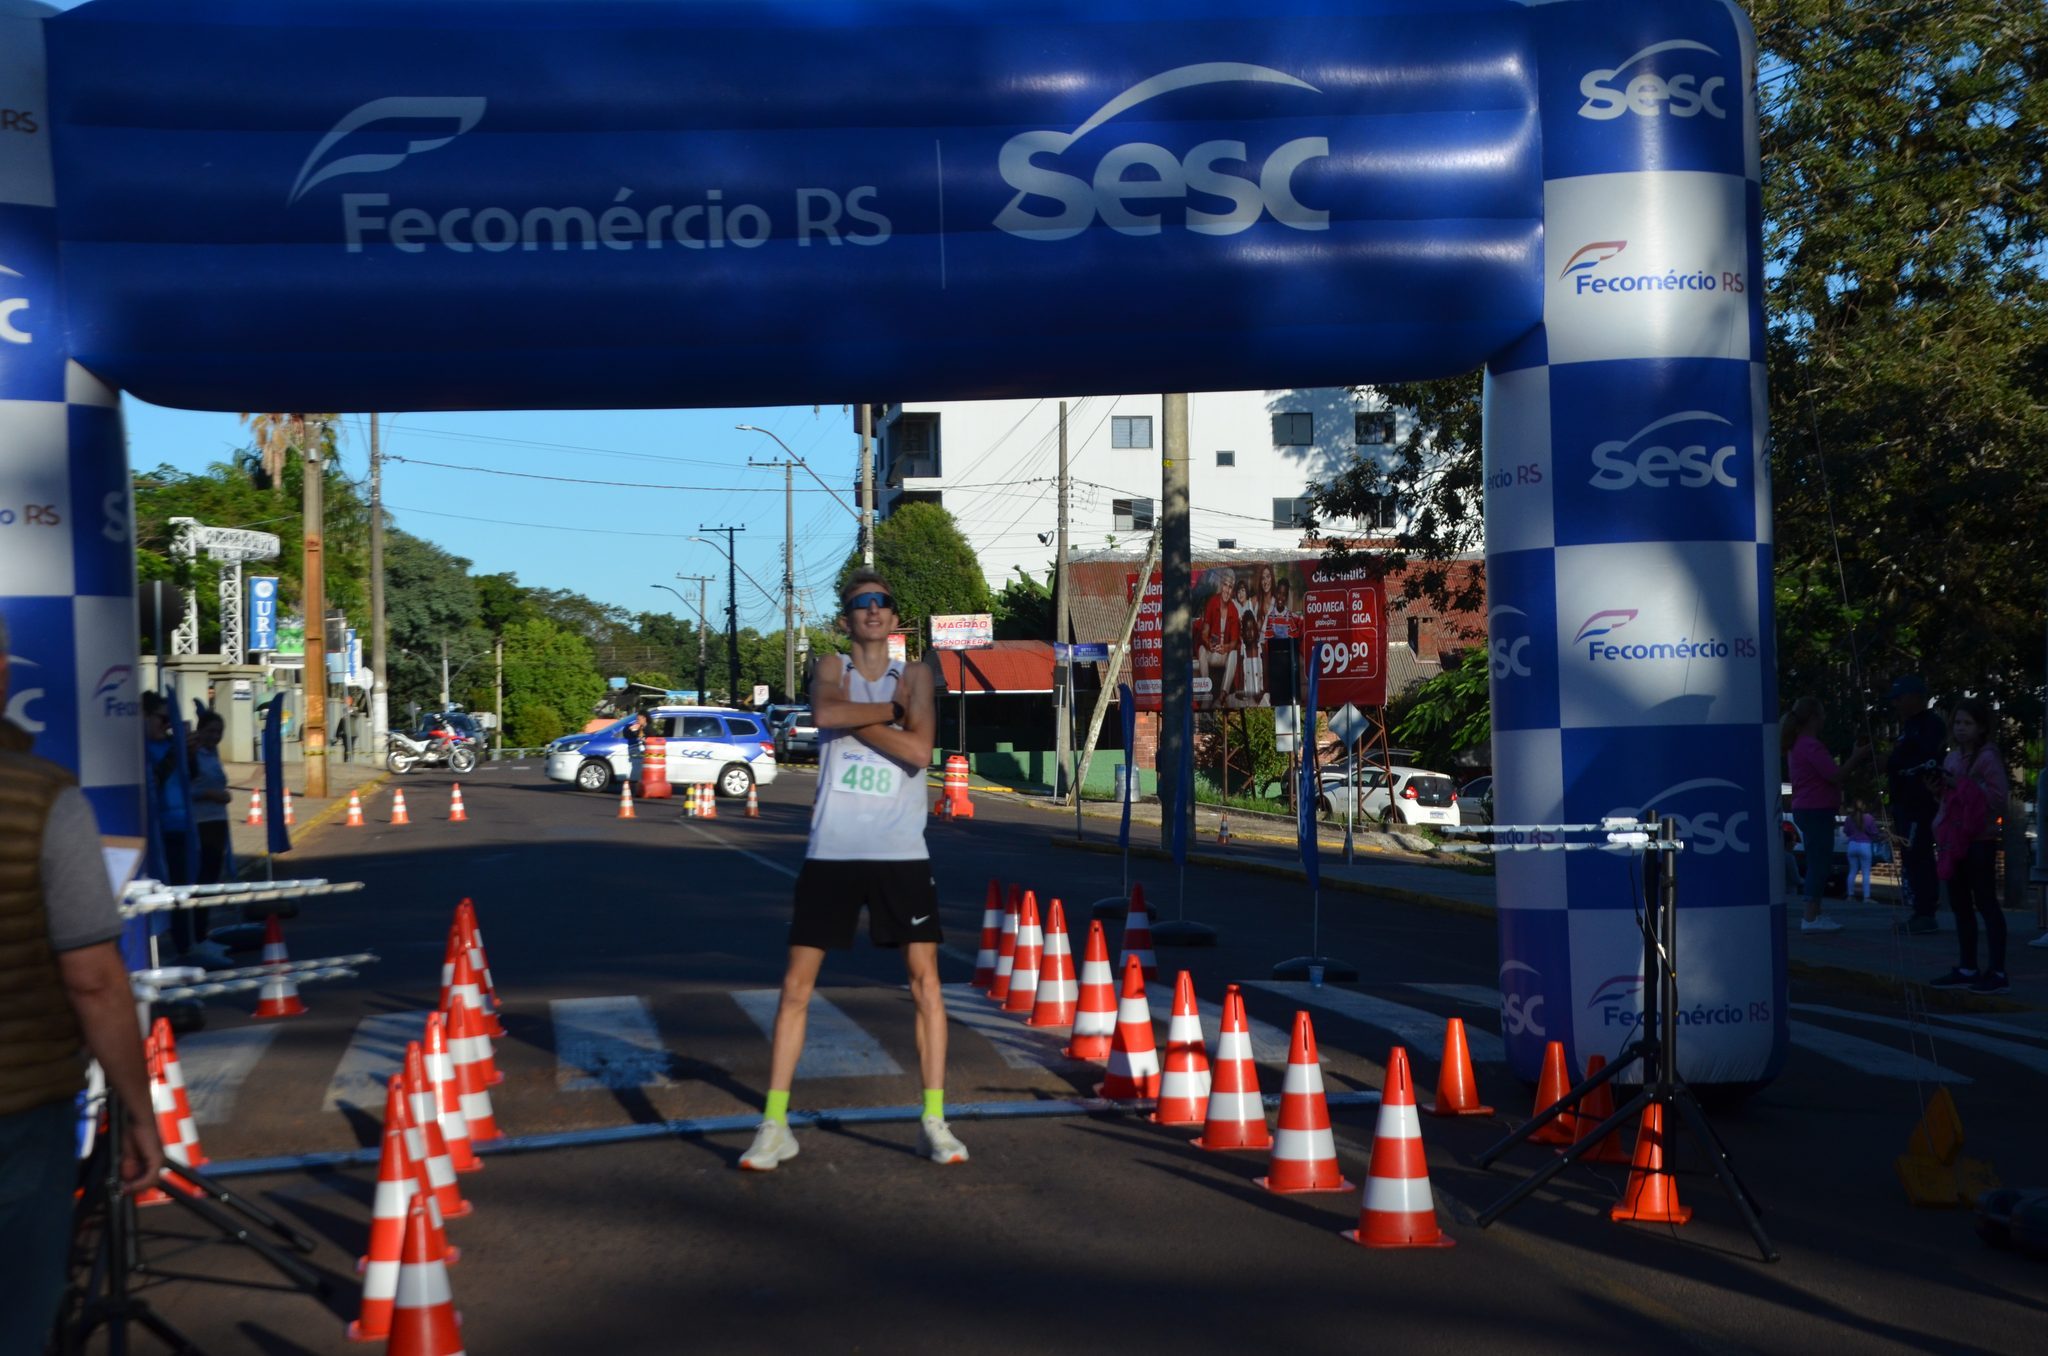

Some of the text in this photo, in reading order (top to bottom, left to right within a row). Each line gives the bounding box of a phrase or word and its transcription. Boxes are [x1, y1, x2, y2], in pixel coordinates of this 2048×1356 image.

[1577, 69, 1726, 121] Sesc
[1, 109, 38, 134] RS
[992, 130, 1330, 241] Sesc
[342, 186, 892, 253] Fecomércio RS
[1576, 269, 1745, 295] Fecomércio RS
[1517, 463, 1543, 485] RS
[1588, 440, 1737, 490] Sesc
[25, 504, 61, 527] RS
[1307, 601, 1345, 613] 600 MEGA
[1352, 600, 1363, 611] 60
[1352, 613, 1371, 623] GIGA
[256, 600, 272, 648] URI
[1589, 638, 1757, 661] Fecomércio RS
[841, 763, 893, 794] 488
[1750, 1001, 1770, 1022] RS
